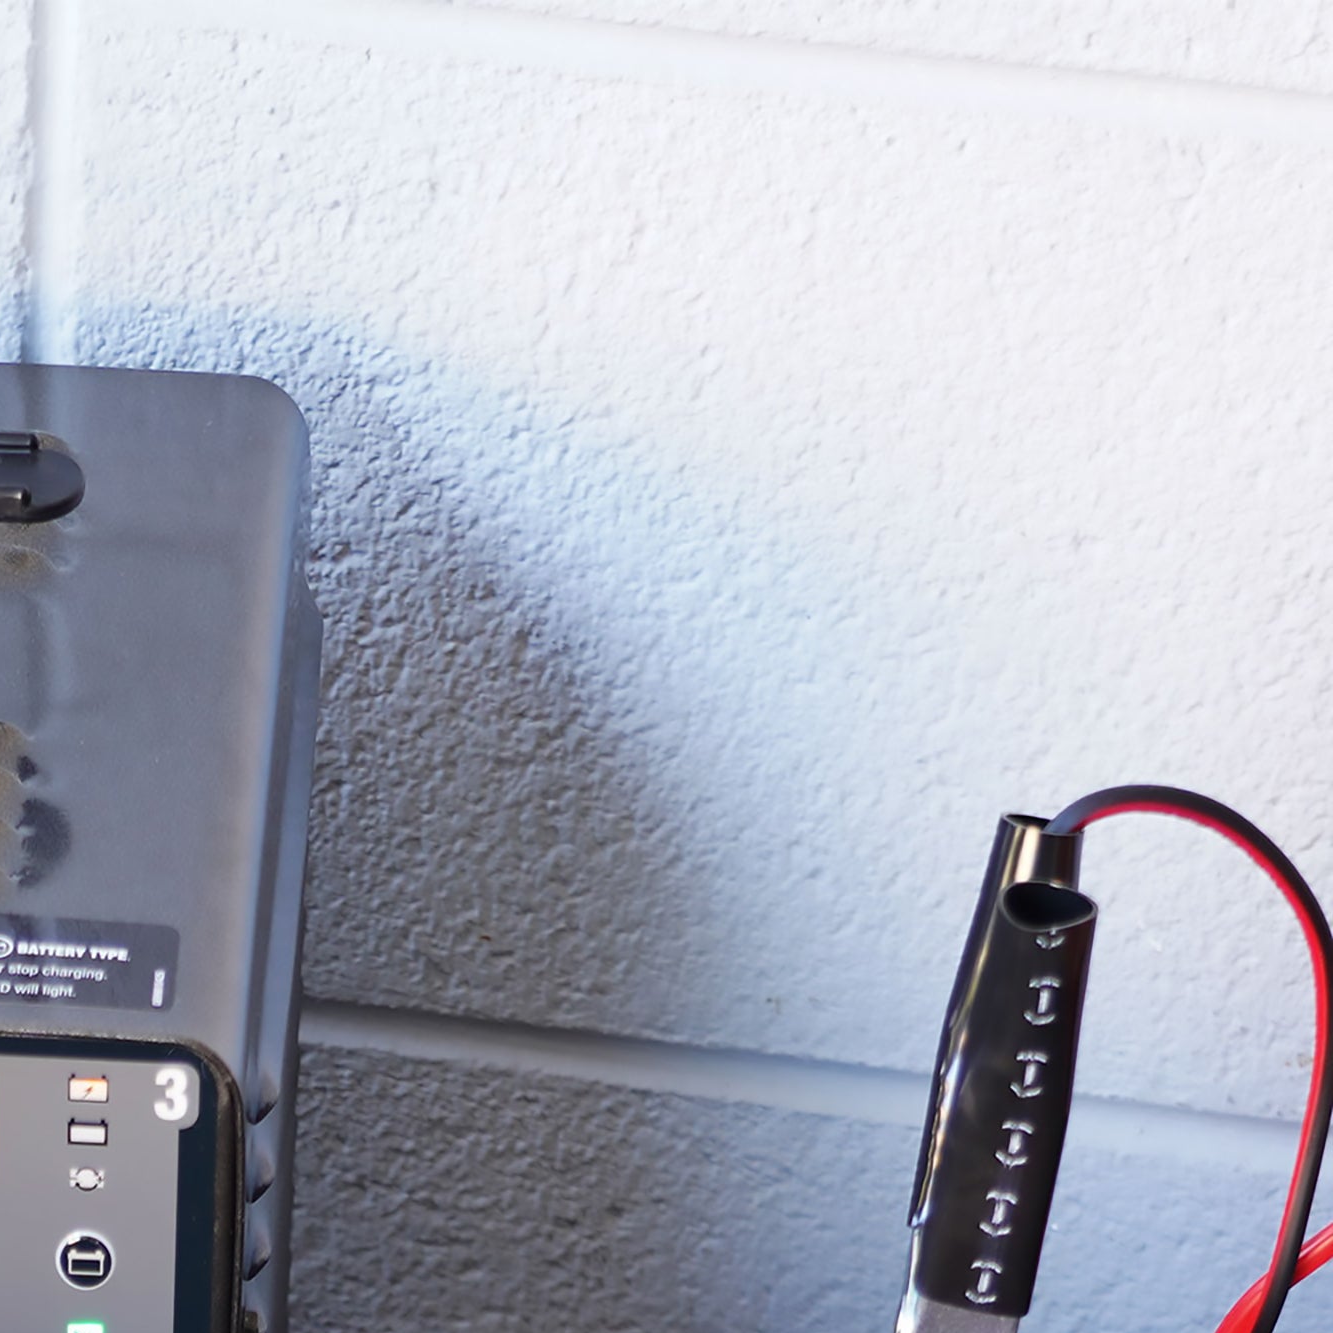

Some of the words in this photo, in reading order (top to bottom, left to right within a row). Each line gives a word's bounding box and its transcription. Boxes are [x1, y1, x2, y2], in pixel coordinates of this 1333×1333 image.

[17, 942, 87, 959] BATTERY
[90, 947, 131, 962] TYPE.
[8, 964, 38, 977] stop
[42, 966, 107, 981] charging.
[14, 984, 38, 996] will
[42, 985, 76, 998] light.
[153, 1068, 188, 1121] 3
